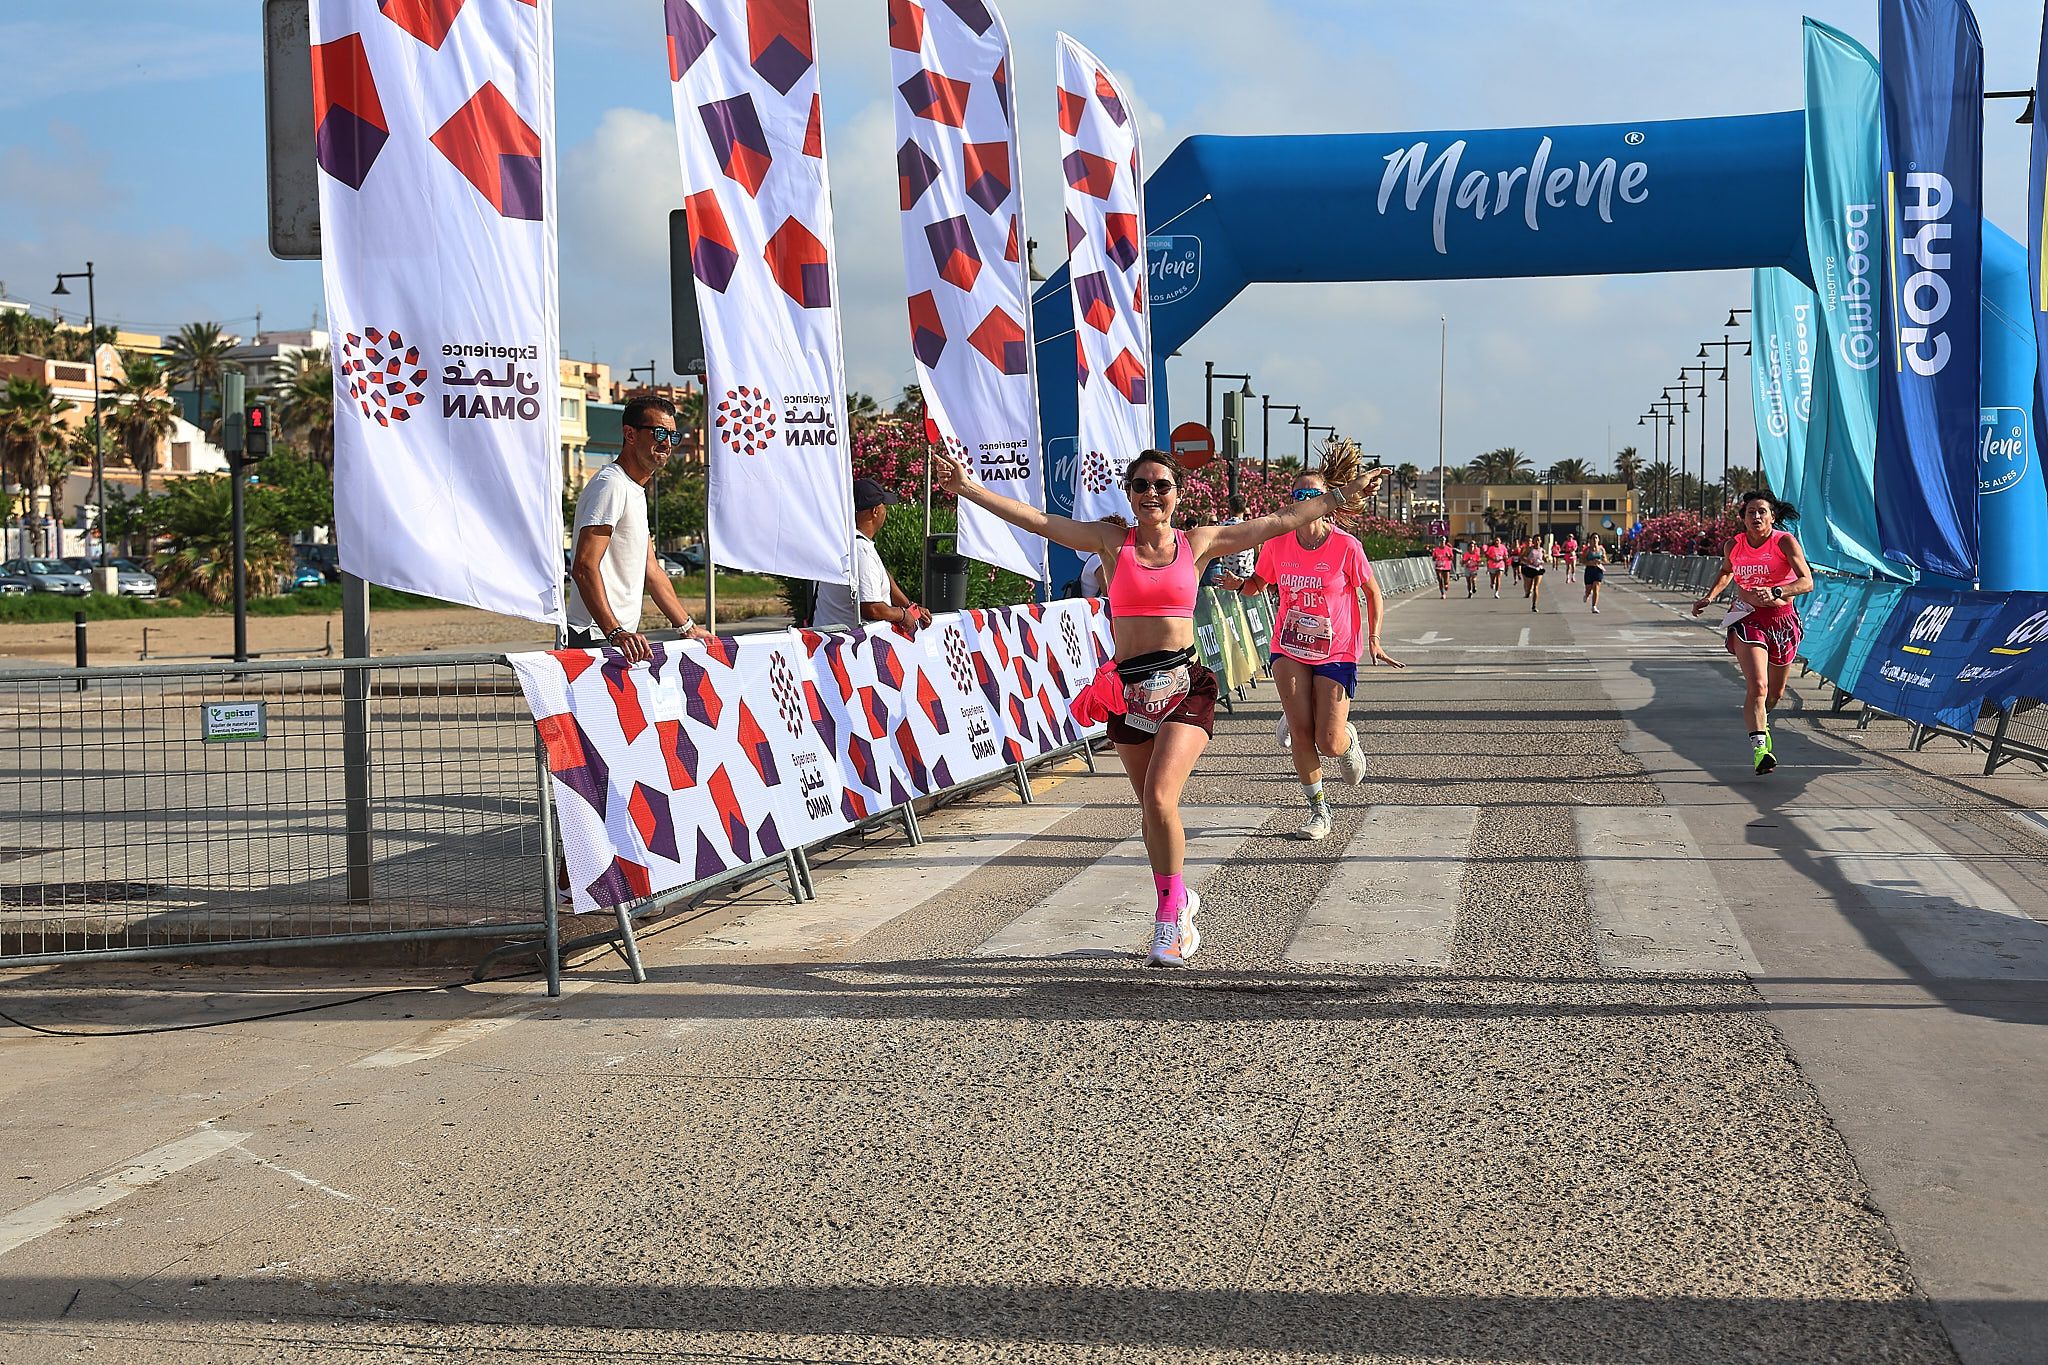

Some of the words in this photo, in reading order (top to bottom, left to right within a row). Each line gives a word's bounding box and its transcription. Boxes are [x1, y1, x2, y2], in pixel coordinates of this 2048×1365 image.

[1377, 136, 1649, 254] Marlene
[1148, 251, 1195, 280] rlene
[1166, 285, 1188, 299] ALPES
[1981, 427, 2022, 463] lene
[1992, 469, 2017, 487] ALPES
[1280, 573, 1324, 590] CARRERA
[1303, 592, 1318, 608] DE
[1909, 605, 1955, 643] GOYA
[1296, 633, 1316, 644] 016
[960, 704, 985, 719] Experience
[971, 739, 996, 760] OMAN
[791, 751, 817, 768] Experience
[806, 794, 833, 820] OMAN
